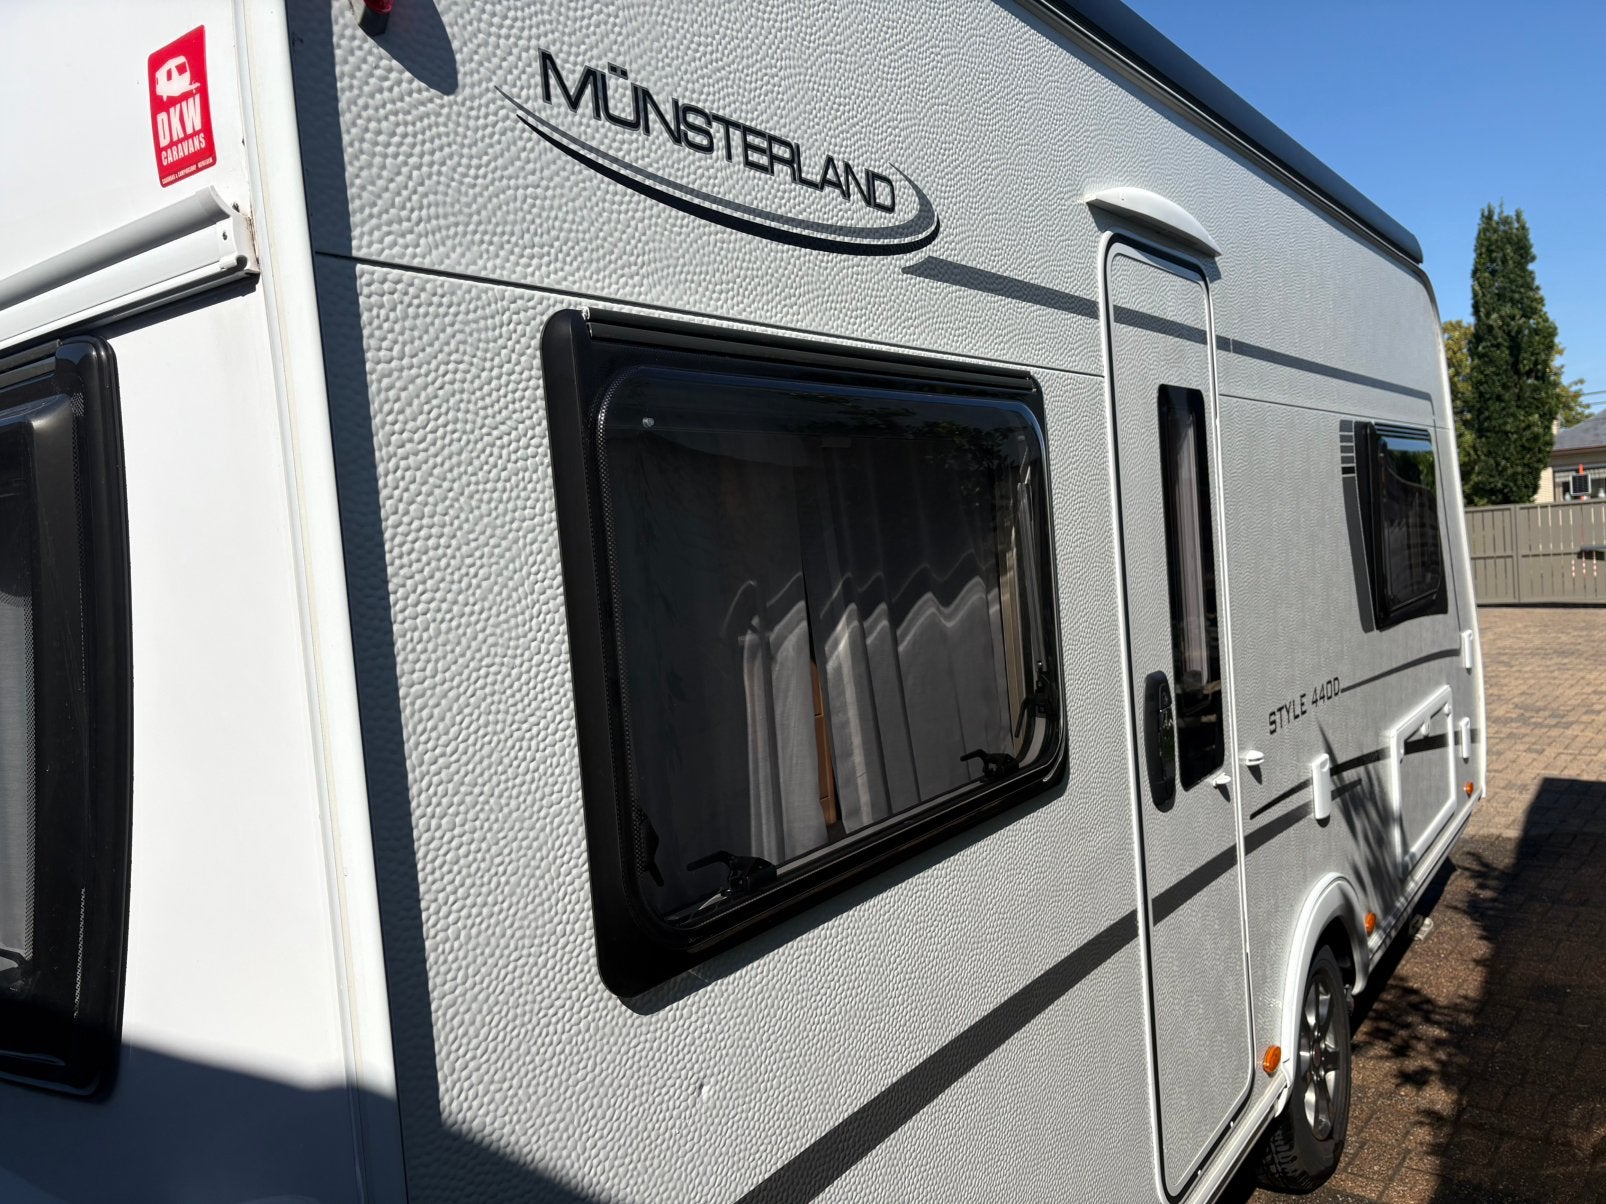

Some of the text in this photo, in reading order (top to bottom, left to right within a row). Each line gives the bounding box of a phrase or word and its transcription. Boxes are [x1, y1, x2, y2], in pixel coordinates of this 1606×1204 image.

[157, 93, 202, 148] DKW
[538, 47, 896, 214] MÜNSTERLAND
[161, 133, 206, 166] CARAVANS
[1268, 693, 1307, 735] STYLE
